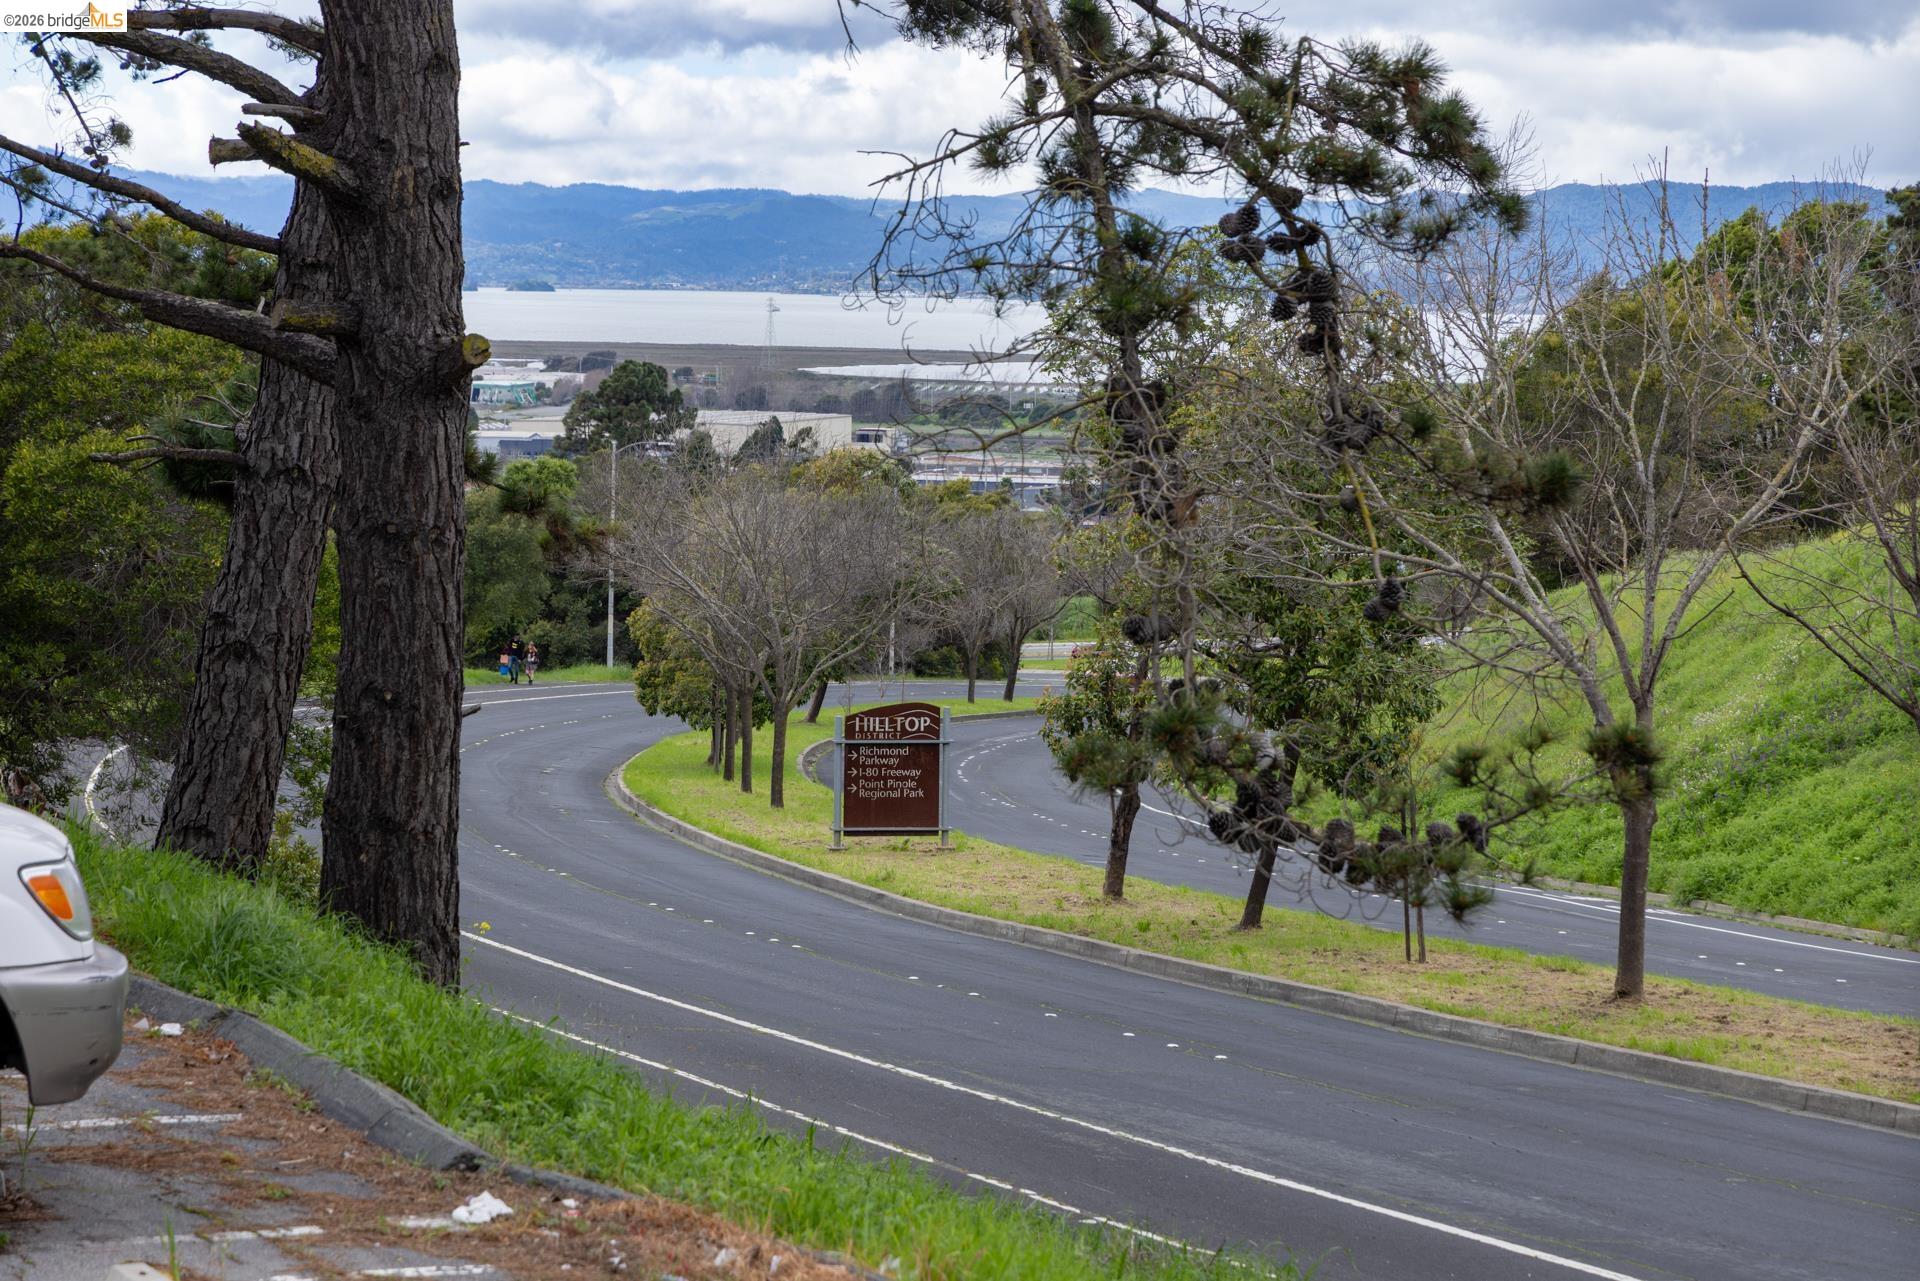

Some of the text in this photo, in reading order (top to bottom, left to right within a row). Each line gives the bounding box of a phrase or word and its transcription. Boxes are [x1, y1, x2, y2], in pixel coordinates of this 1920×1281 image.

[855, 717, 930, 731] HILLTOP
[860, 746, 909, 756] Richmond
[860, 756, 900, 767] Parkway
[860, 767, 921, 779] I-80 Freeway
[860, 779, 917, 788] Point Pinole
[860, 789, 924, 800] Regional Park
